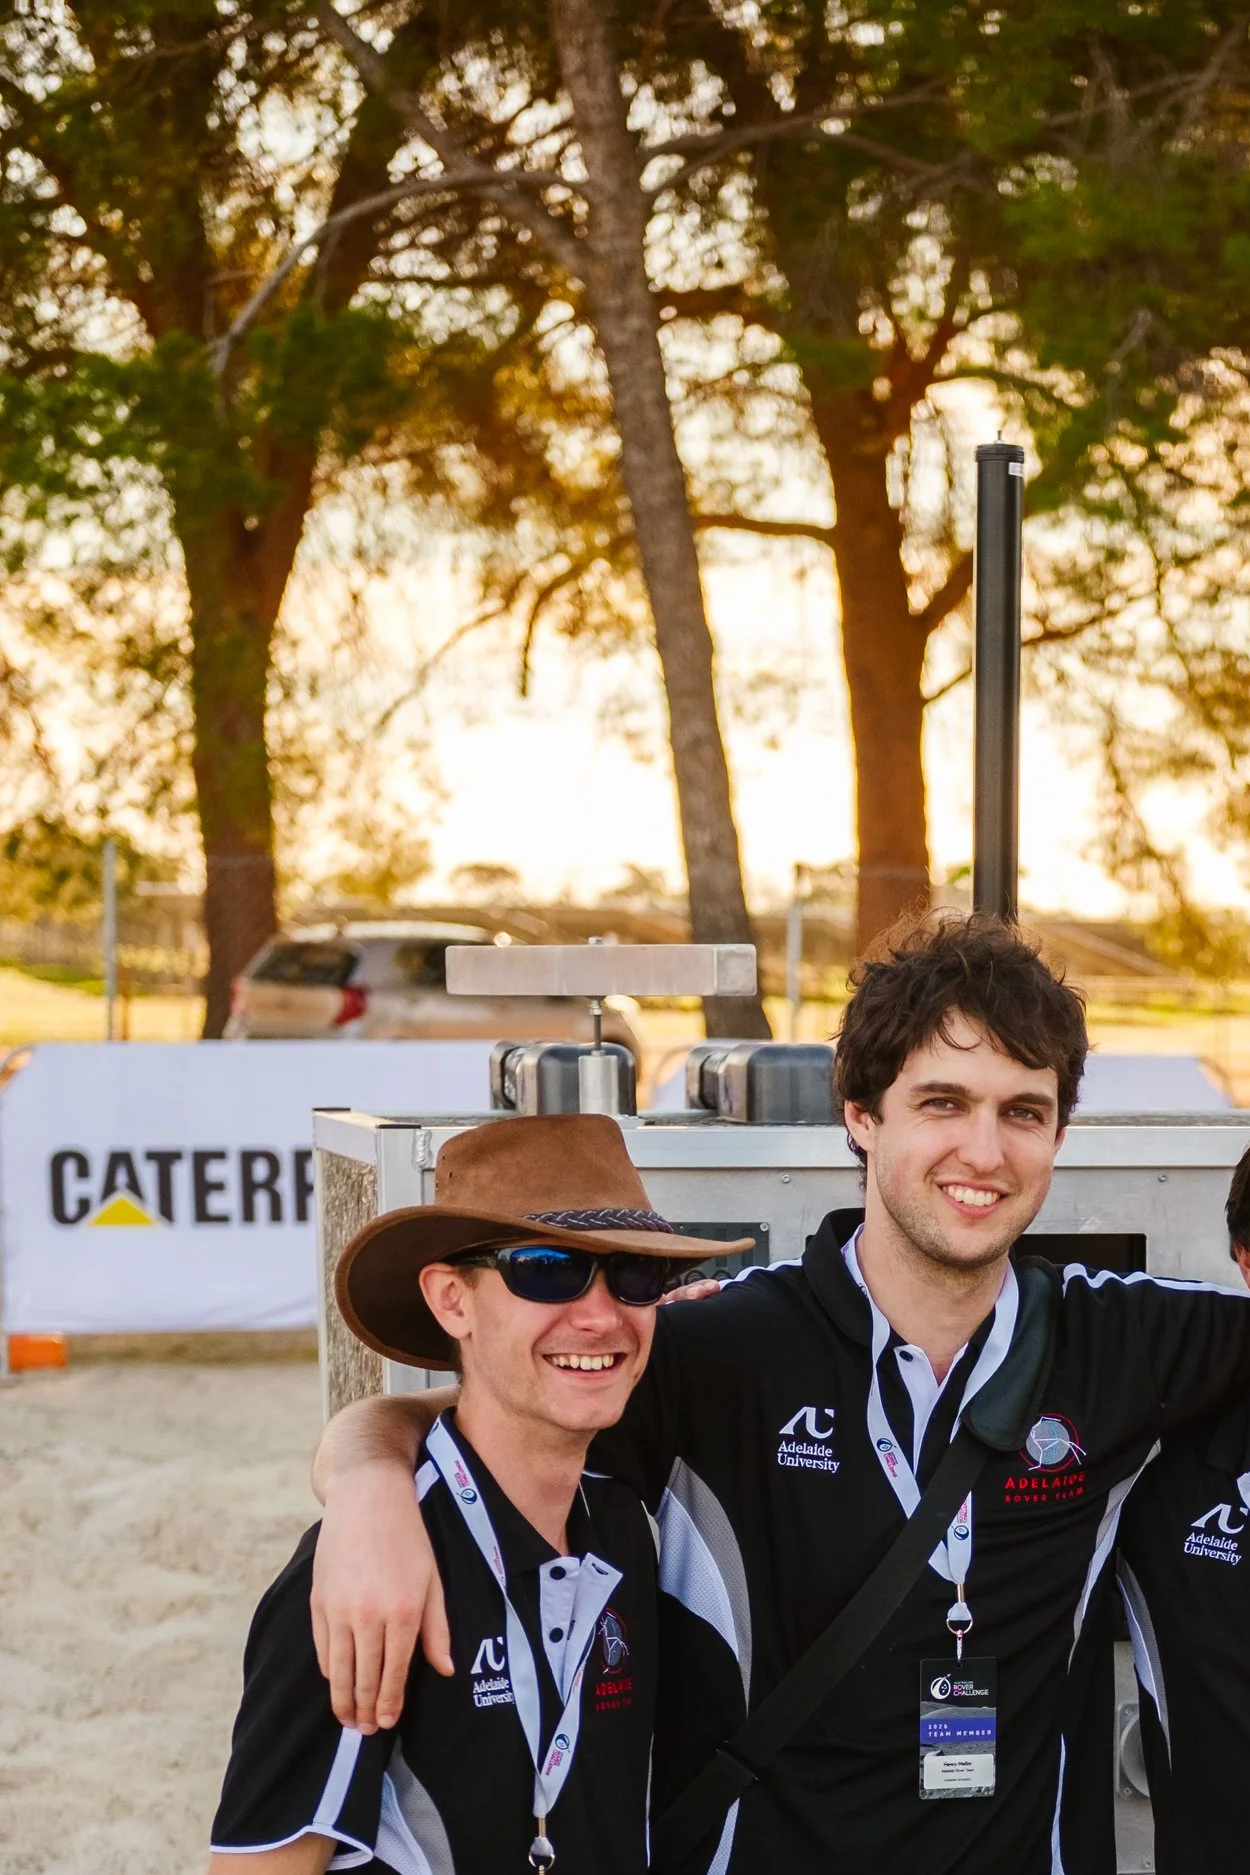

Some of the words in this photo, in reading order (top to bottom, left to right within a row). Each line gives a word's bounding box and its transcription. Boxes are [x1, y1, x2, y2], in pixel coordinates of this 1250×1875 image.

[778, 1440, 832, 1457] Adelaide
[777, 1453, 840, 1473] University
[1004, 1471, 1087, 1489] ADELAIDE
[1004, 1493, 1047, 1503] ROVER
[1186, 1531, 1238, 1551] Adelaide
[1184, 1541, 1242, 1566] University
[472, 1677, 510, 1694] Adelaide
